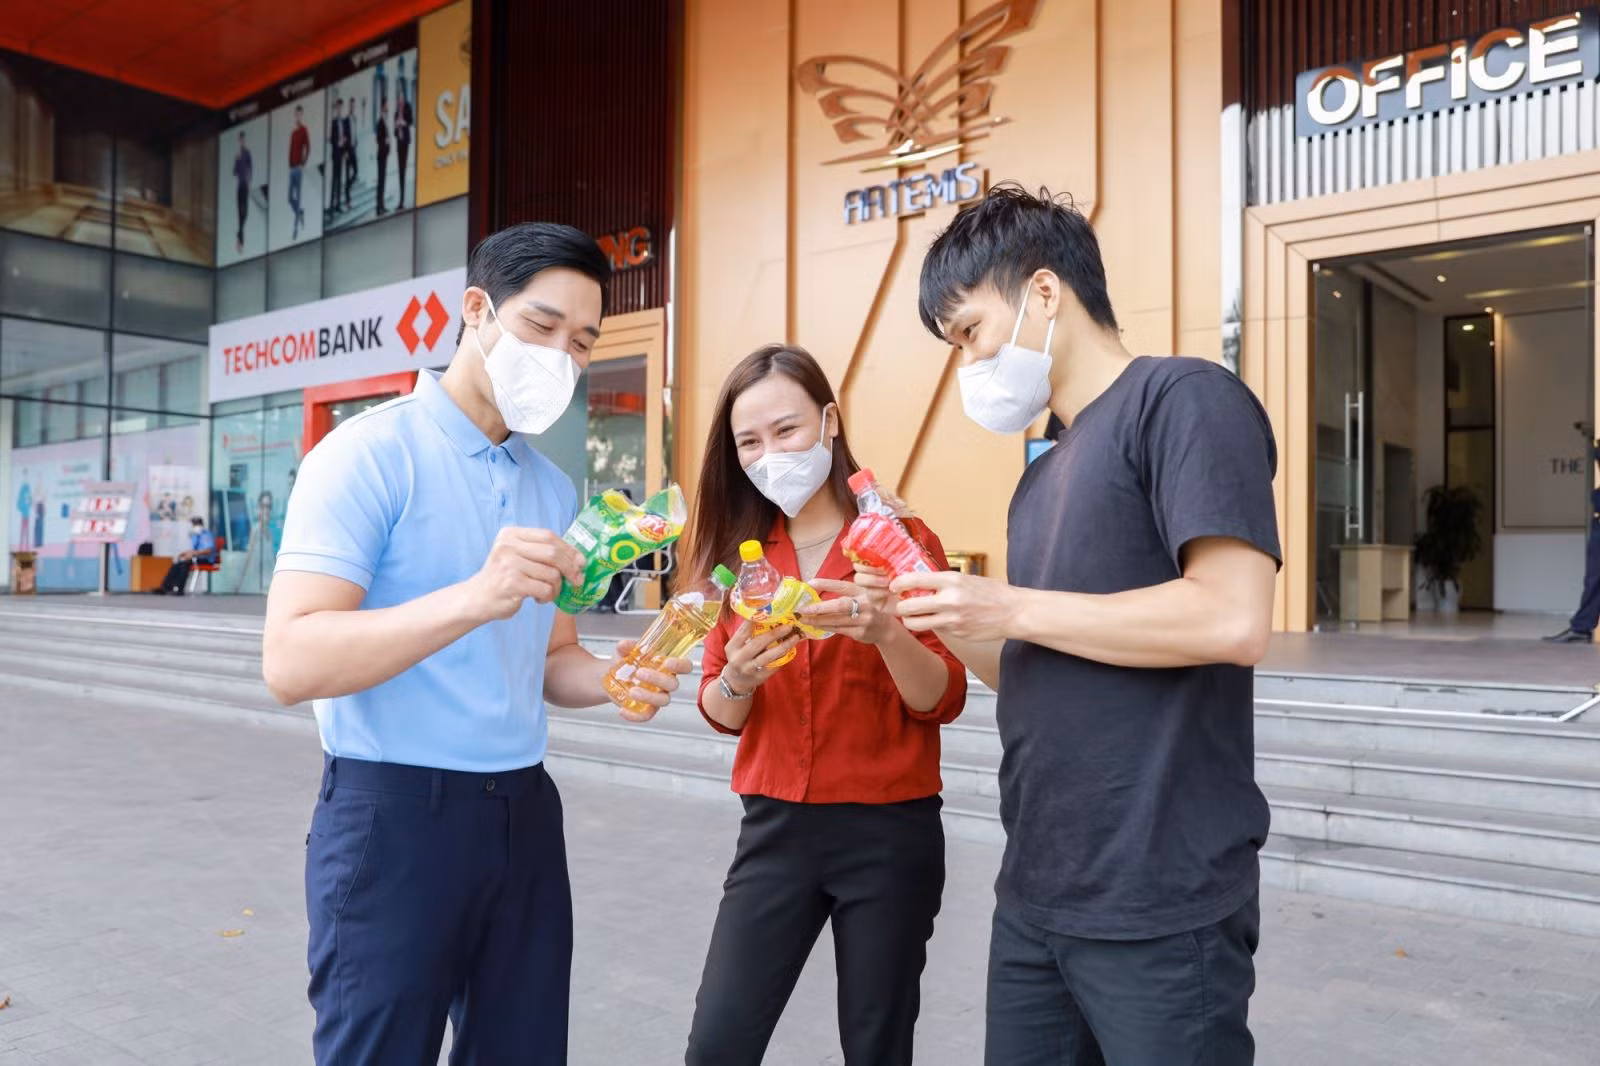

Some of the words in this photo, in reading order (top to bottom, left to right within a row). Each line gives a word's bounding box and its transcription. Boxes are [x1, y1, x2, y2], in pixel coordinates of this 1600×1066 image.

[1307, 12, 1582, 125] OFFICE
[843, 161, 979, 225] ARTEMIS
[223, 316, 383, 376] TECHCOMBANK
